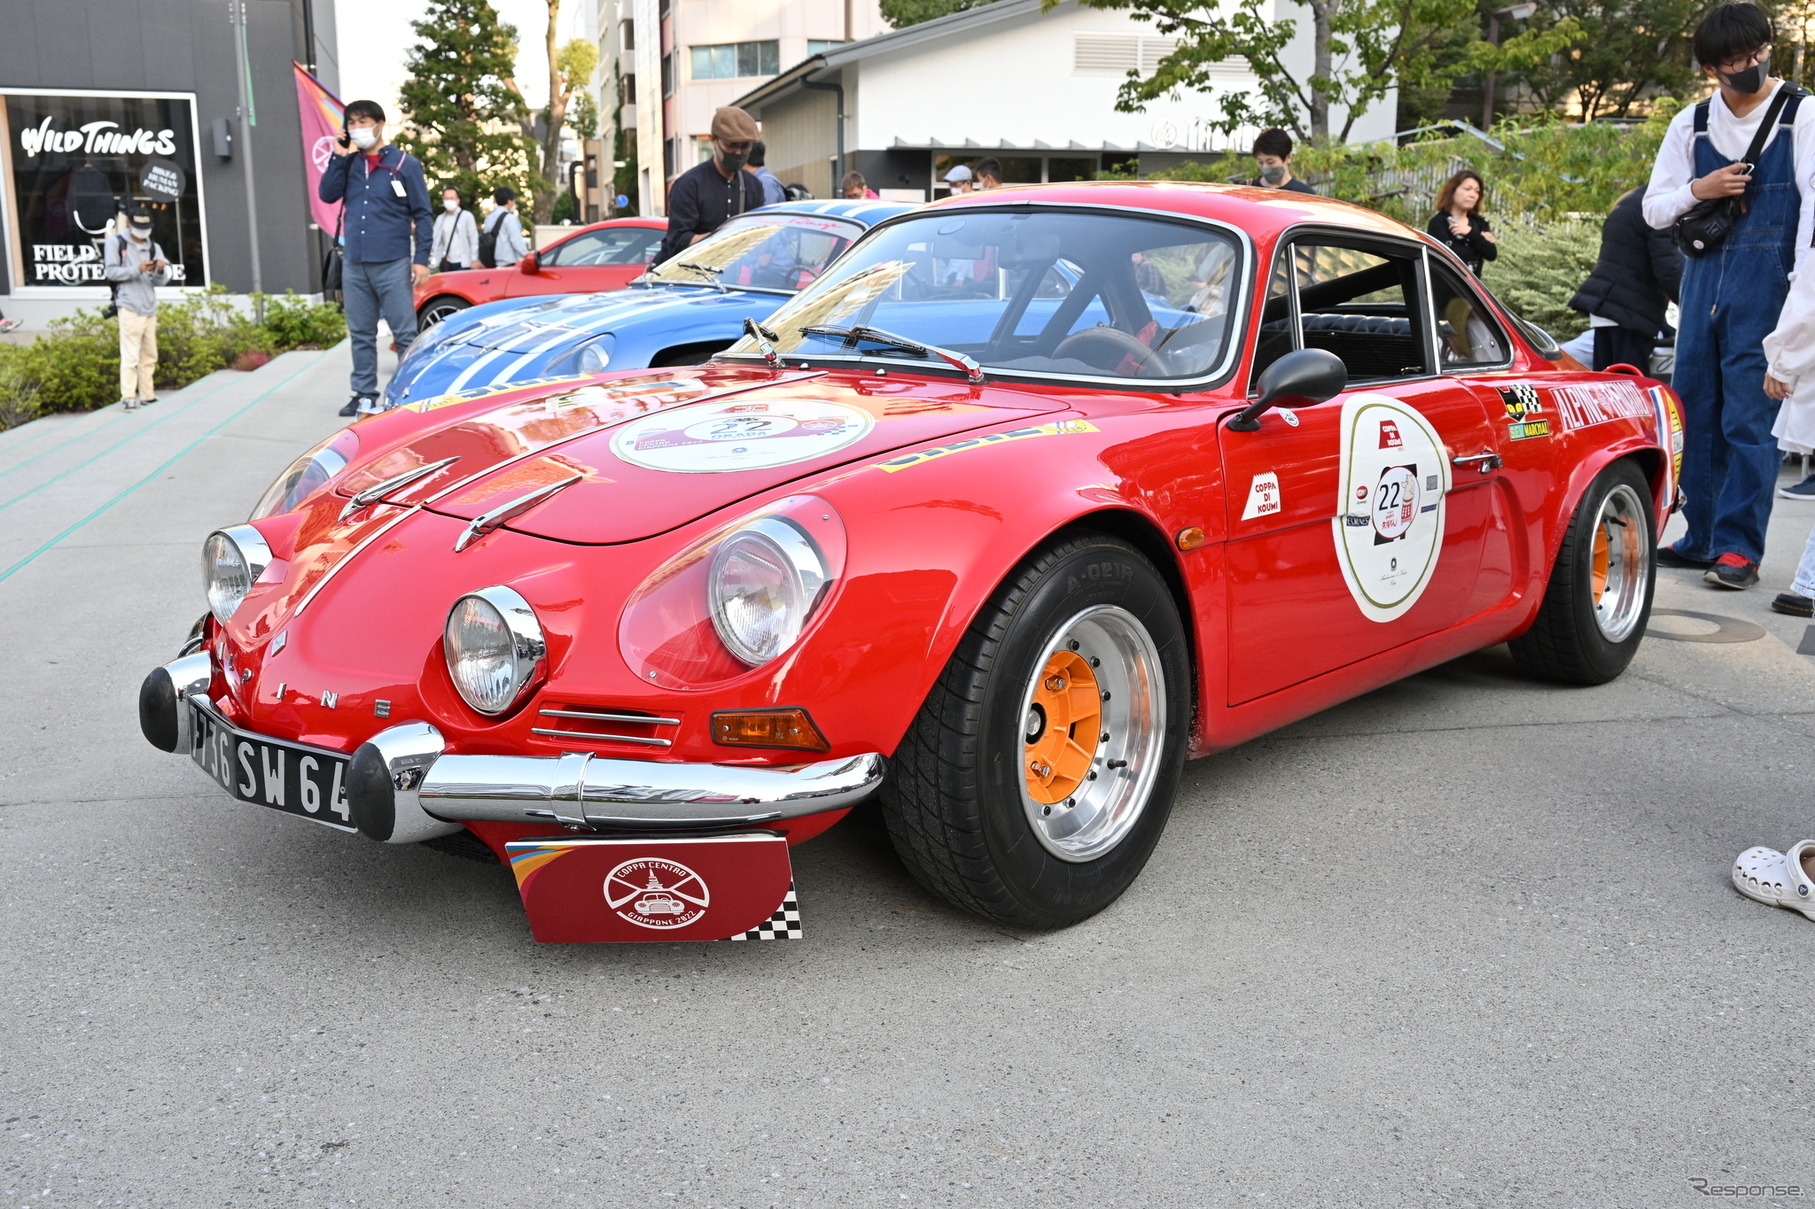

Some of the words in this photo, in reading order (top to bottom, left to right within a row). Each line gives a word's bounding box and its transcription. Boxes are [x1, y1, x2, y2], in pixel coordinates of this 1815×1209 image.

[32, 244, 96, 261] FIELD
[1553, 386, 1608, 430] ALPINE
[710, 421, 772, 434] 22
[1255, 482, 1277, 493] COPPA
[1263, 493, 1271, 502] DI
[1378, 481, 1400, 511] 22
[1257, 501, 1279, 514] KOUMI
[237, 741, 286, 808] SW
[300, 755, 350, 822] 64
[617, 862, 646, 878] COPPA
[648, 861, 687, 877] CENTRO
[627, 911, 674, 926] GIAPPONE
[675, 910, 697, 925] 2022
